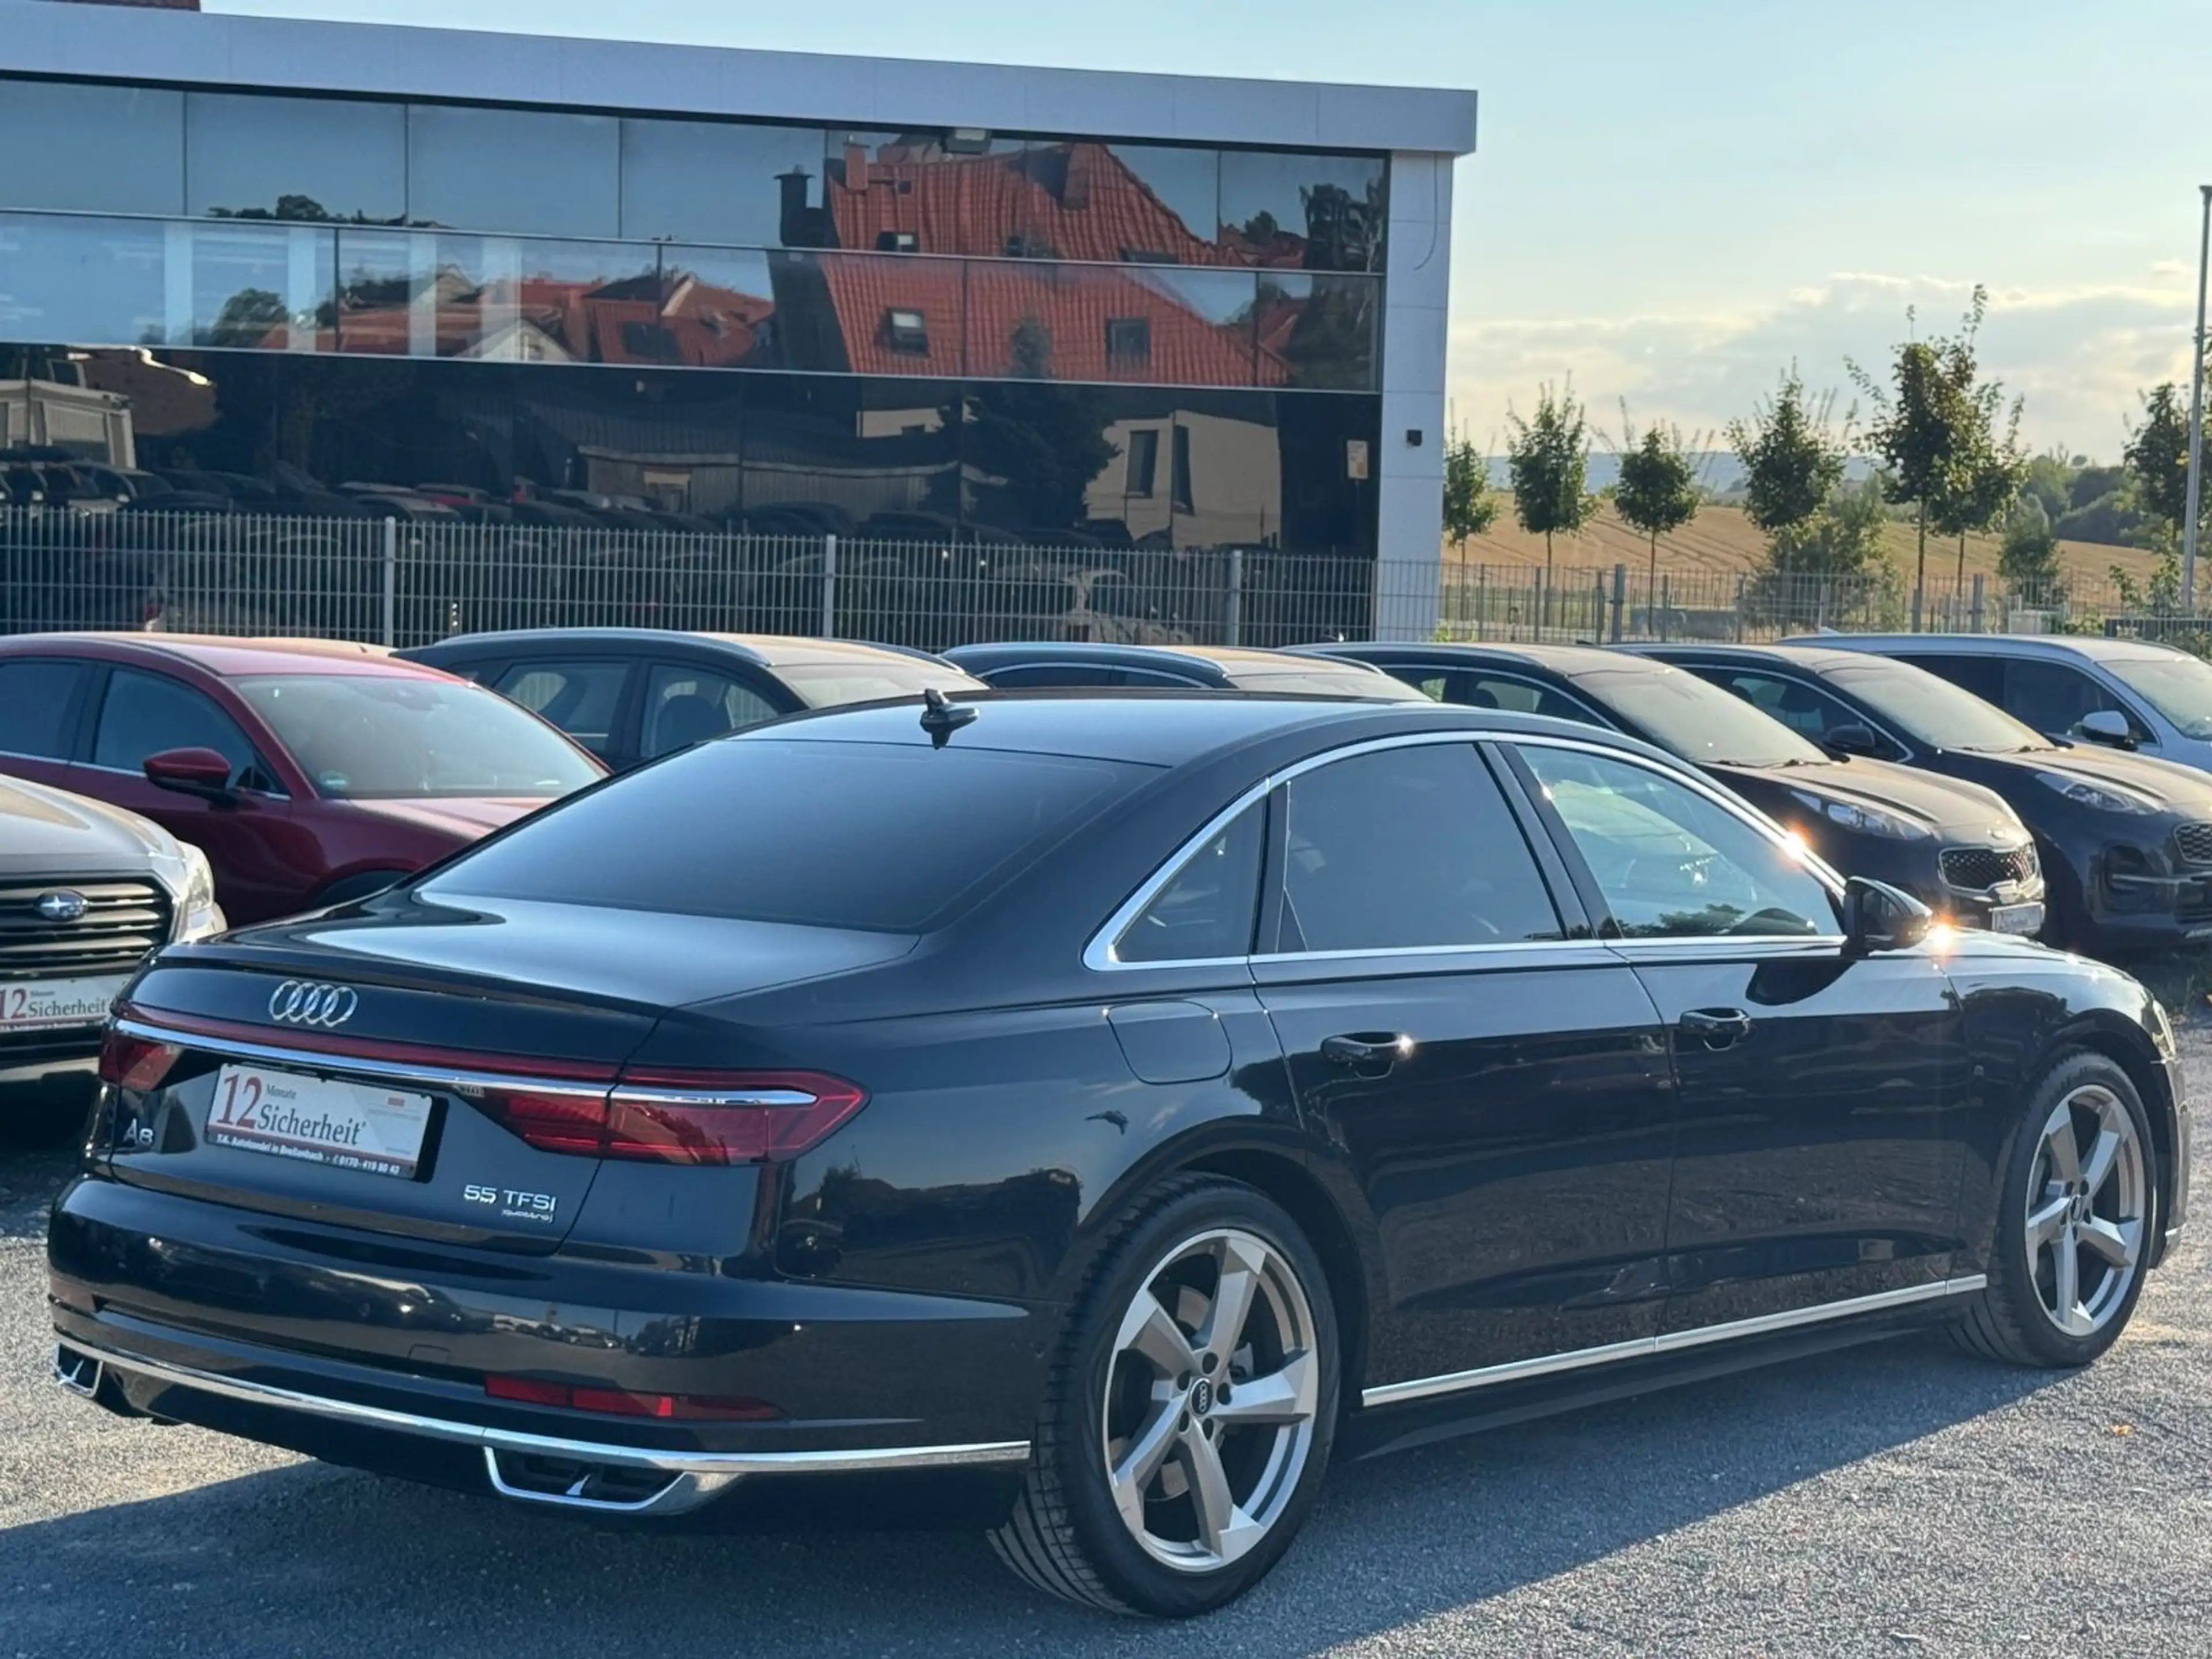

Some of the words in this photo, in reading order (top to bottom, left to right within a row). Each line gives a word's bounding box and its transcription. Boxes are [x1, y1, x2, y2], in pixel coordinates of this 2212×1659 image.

[217, 1073, 262, 1129] 12
[122, 1118, 154, 1145] A8
[464, 1185, 497, 1204] 55
[503, 1190, 556, 1211] TFSI
